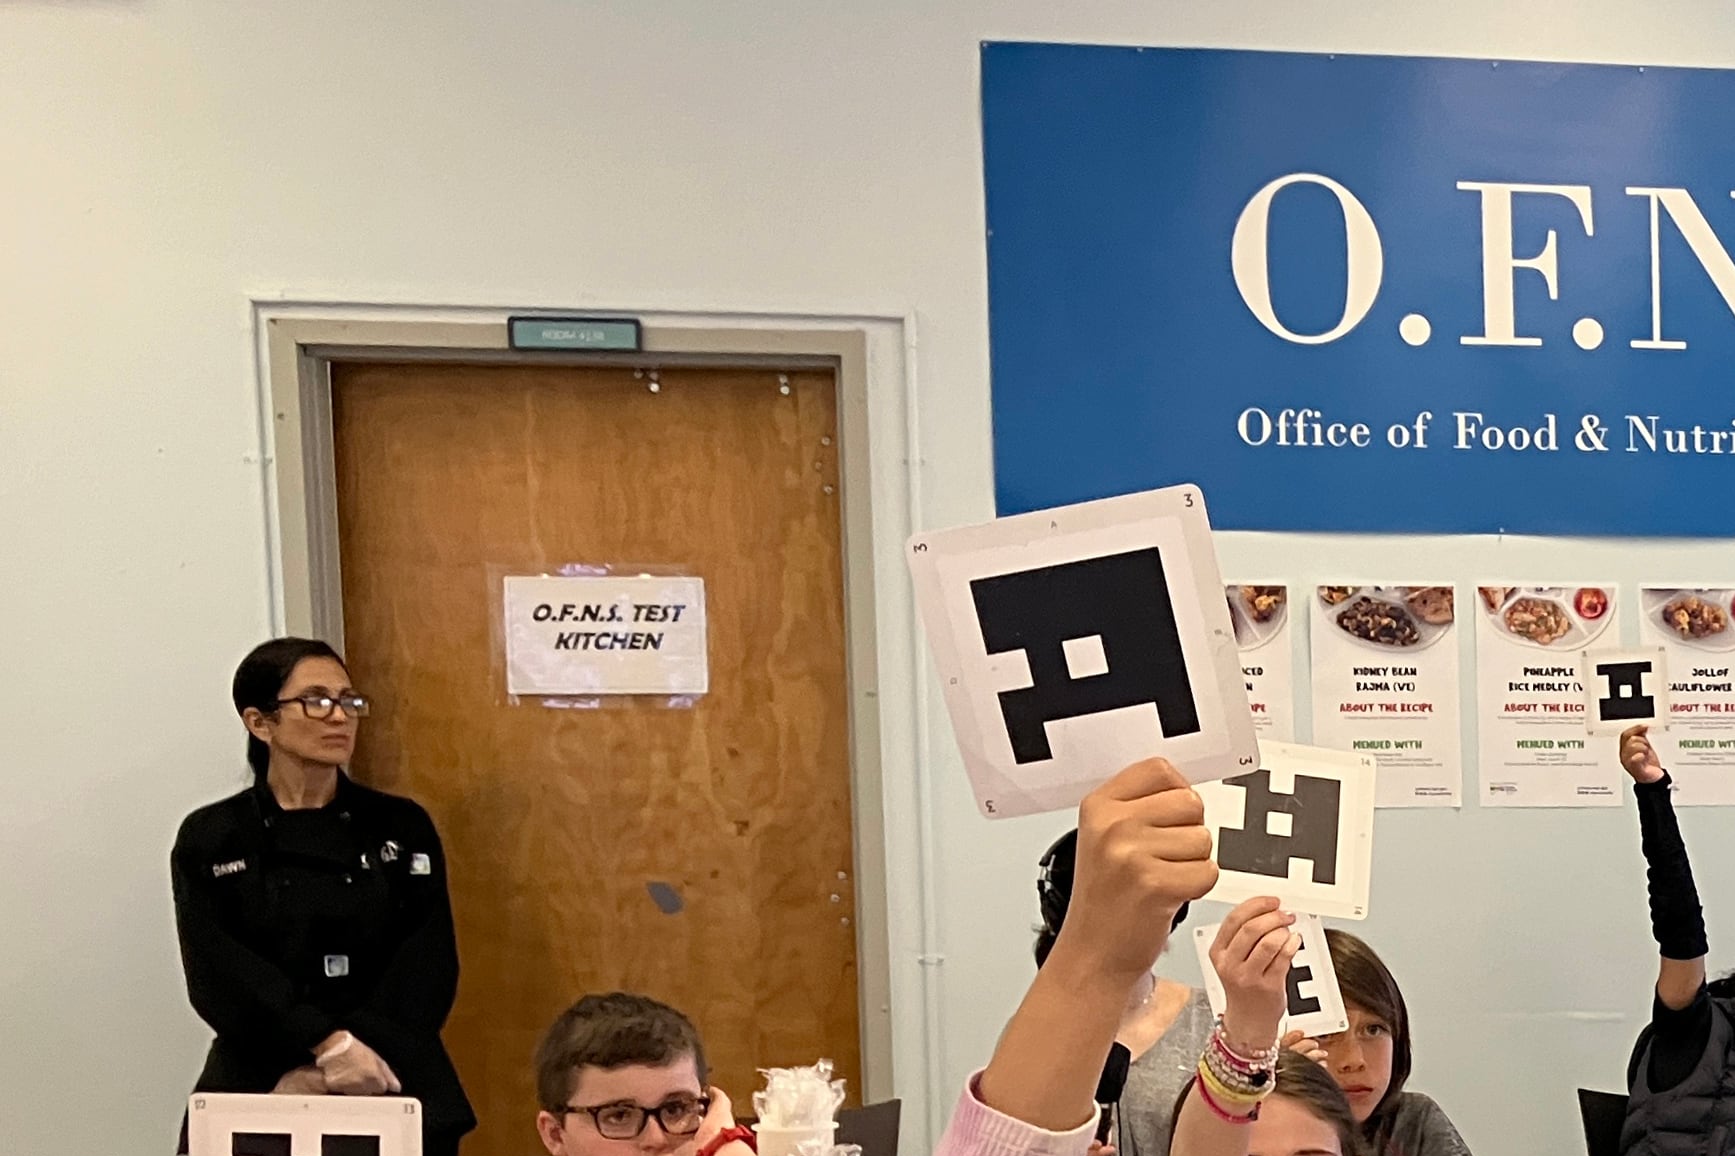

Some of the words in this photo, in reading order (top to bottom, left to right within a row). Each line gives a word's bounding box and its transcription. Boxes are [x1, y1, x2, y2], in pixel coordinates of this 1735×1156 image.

[1237, 408, 1371, 450] Office
[1387, 410, 1432, 450] of
[1453, 411, 1558, 452] Food
[1575, 415, 1609, 453] &
[1183, 493, 1195, 509] 3
[913, 542, 928, 554] 3
[533, 603, 623, 622] O.F.N.S.
[633, 603, 686, 622] TEST
[554, 631, 664, 651] KITCHEN
[1353, 667, 1389, 676] KIDNEY
[1392, 667, 1417, 676] BEAN
[1523, 667, 1574, 677] PINEAPPLE
[1691, 668, 1729, 677] JOLLOF
[1356, 682, 1390, 692] RAJMA
[1508, 682, 1530, 692] RICE
[1532, 682, 1570, 692] MEDLEY
[1339, 703, 1374, 713] ABOUT
[1378, 703, 1398, 713] THE
[1400, 703, 1434, 713] RECIPE
[1504, 703, 1539, 713] ABOUT
[1542, 703, 1560, 713] THE
[1703, 703, 1722, 713] THE
[1353, 740, 1391, 750] MENUED
[1395, 740, 1423, 750] WITH
[1516, 740, 1555, 749] MENUED
[1558, 740, 1585, 749] WITH
[1239, 755, 1253, 766] 3
[984, 799, 997, 814] 3
[212, 858, 247, 879] DAWN
